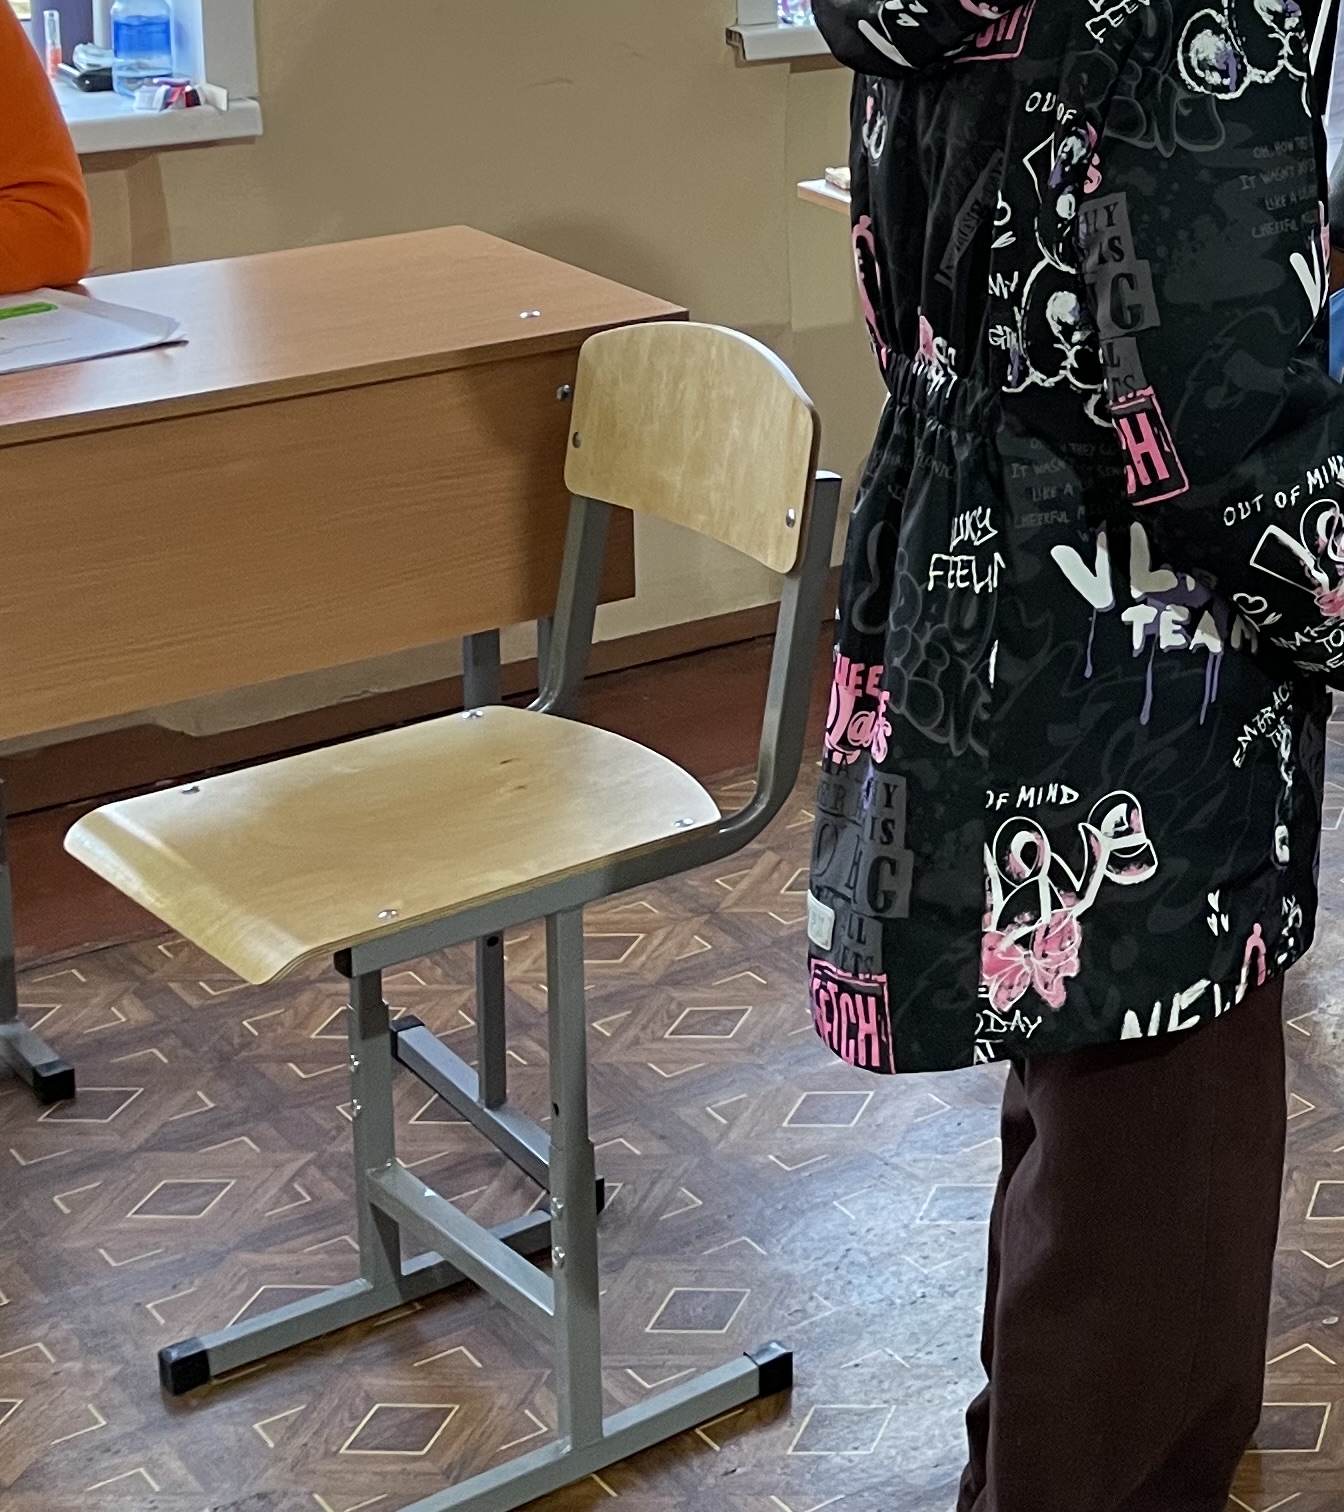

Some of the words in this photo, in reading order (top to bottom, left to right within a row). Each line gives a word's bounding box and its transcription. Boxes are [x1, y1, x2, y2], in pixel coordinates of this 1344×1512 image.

[1223, 494, 1264, 527] OUT
[1274, 485, 1300, 508] OF
[1015, 783, 1080, 809] MIND
